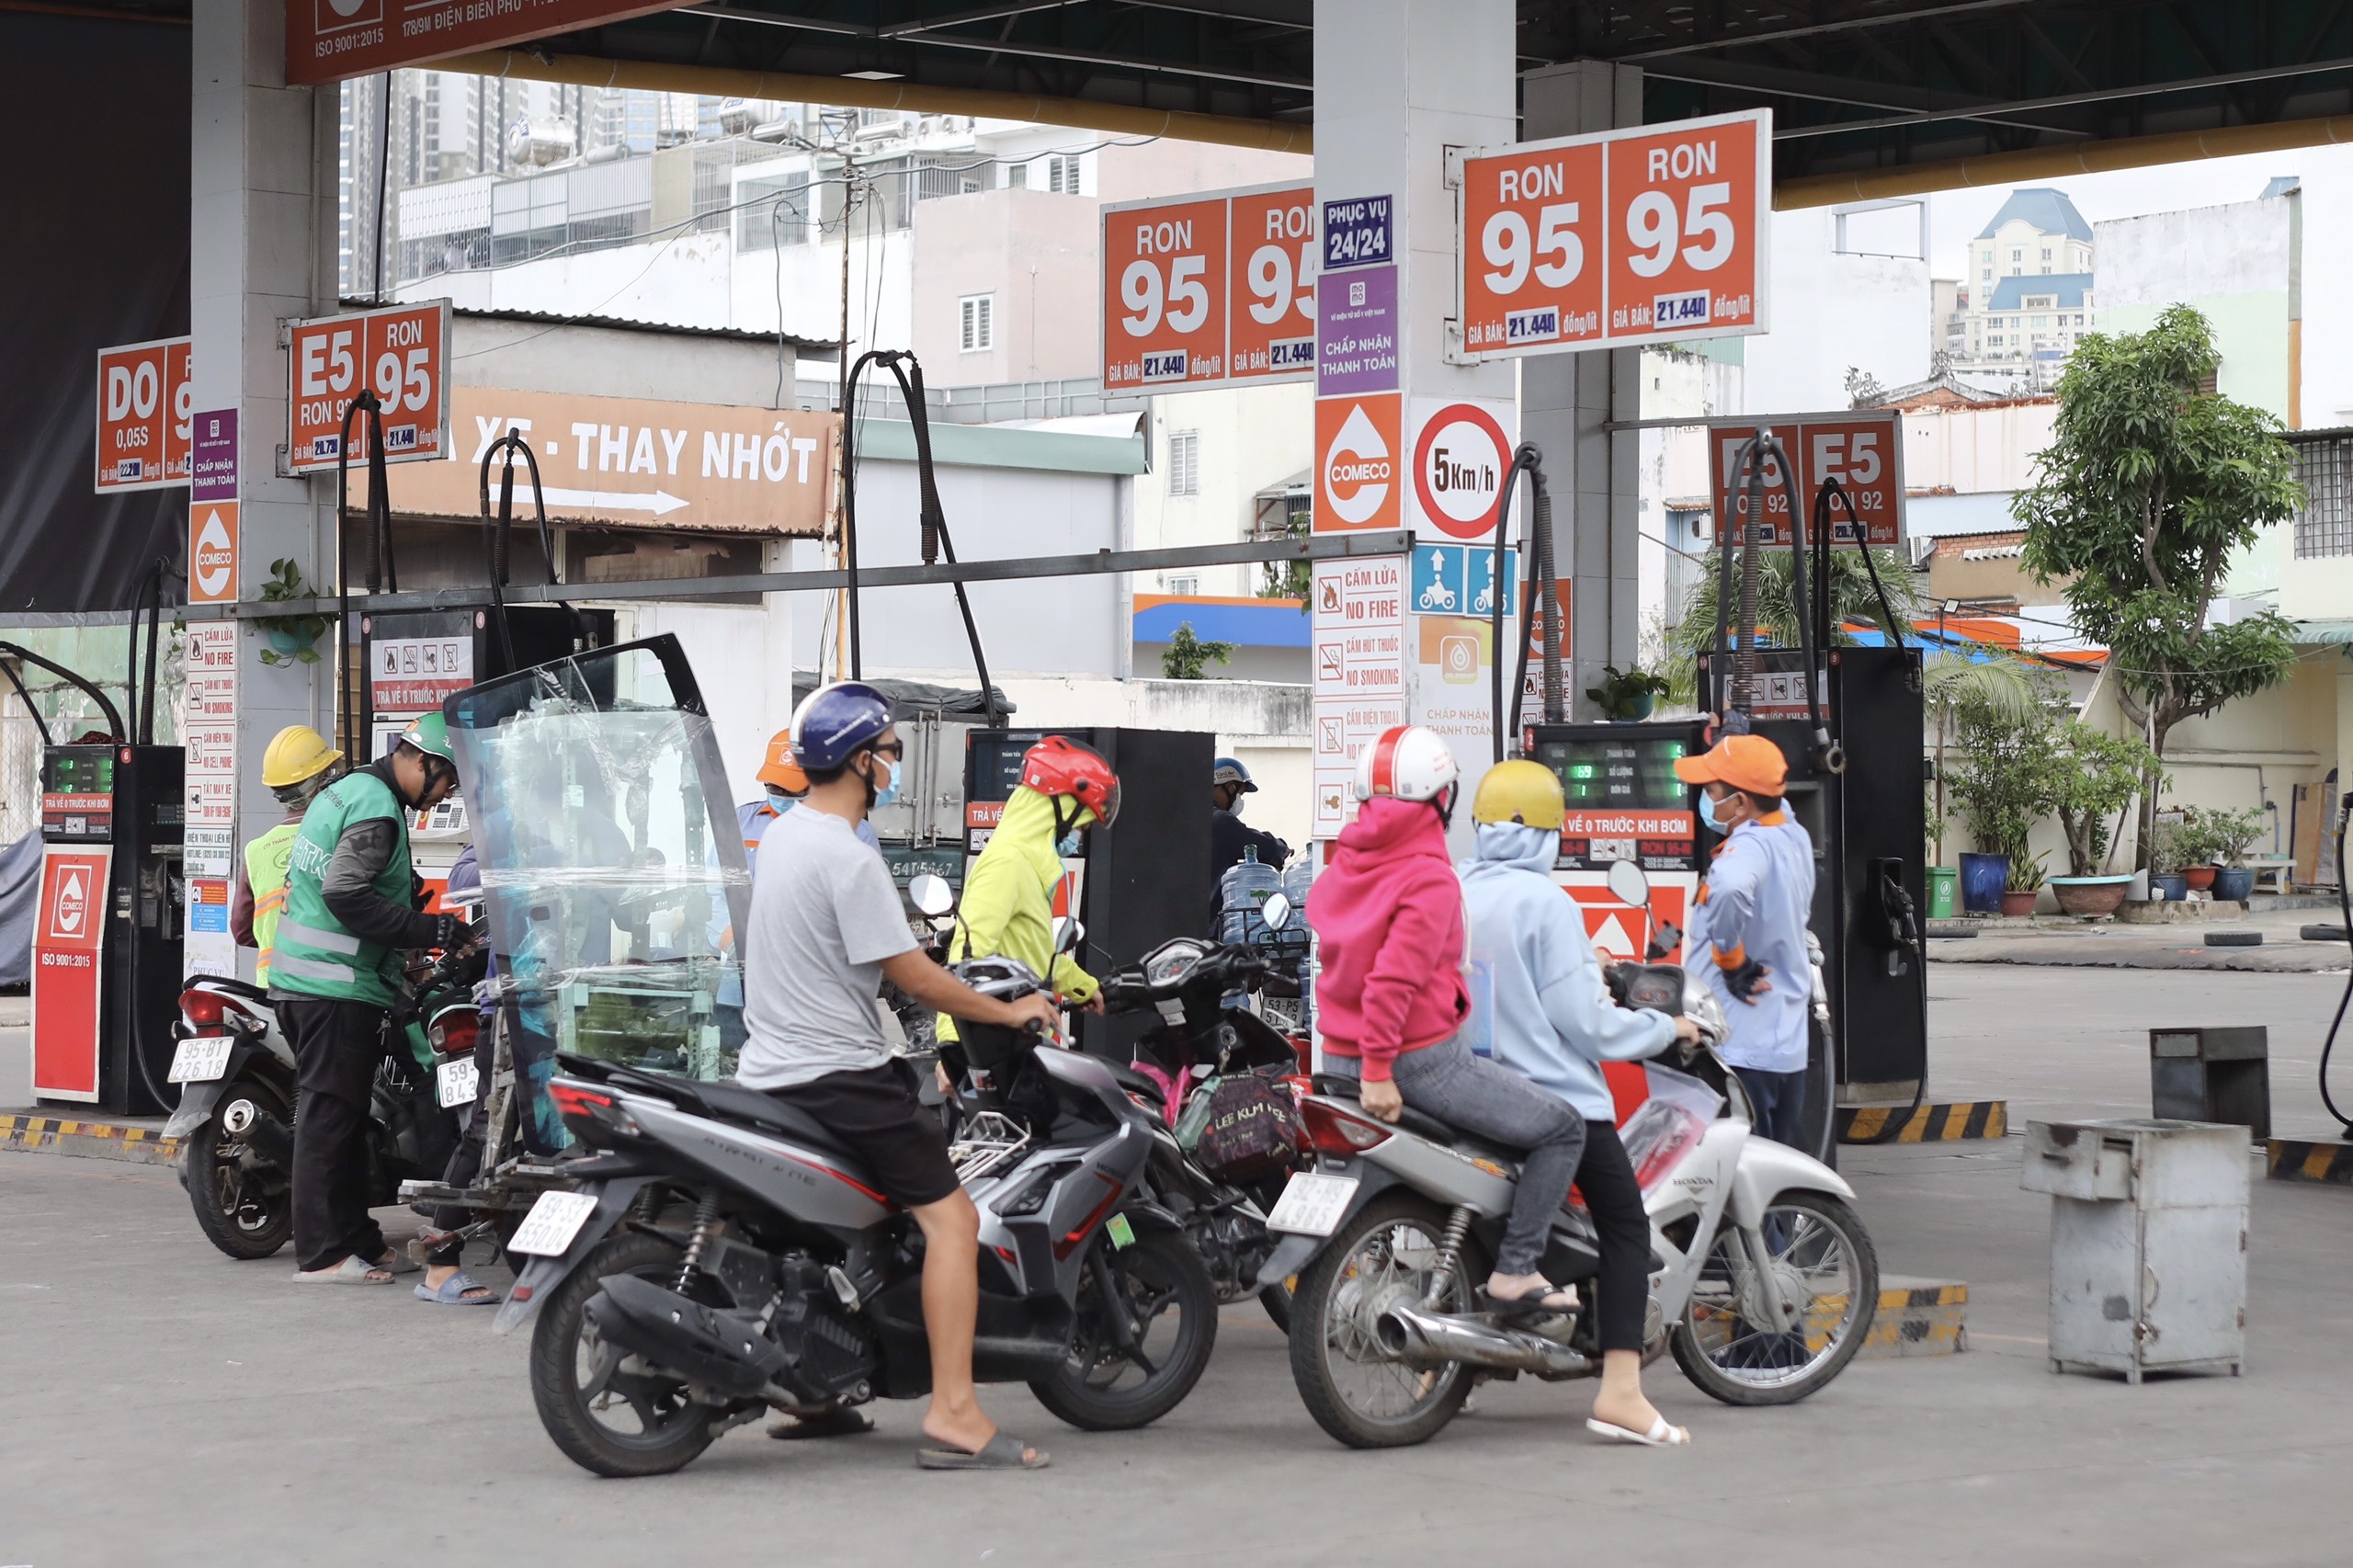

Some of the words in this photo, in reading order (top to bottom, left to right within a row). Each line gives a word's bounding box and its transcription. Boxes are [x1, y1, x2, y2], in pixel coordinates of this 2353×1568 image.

[403, 17, 431, 37] 178/9M
[435, 6, 461, 30] ĐIỆN
[315, 43, 333, 57] ISO
[335, 28, 384, 53] 9001:2015
[1648, 141, 1716, 182] RON
[1500, 163, 1563, 202] RON
[1328, 204, 1364, 226] PHỤC
[1369, 199, 1386, 222] VỤ
[1136, 220, 1191, 255] RON
[1627, 182, 1734, 278] 95
[1330, 227, 1385, 261] 24/24
[1482, 201, 1584, 295] 95
[1120, 255, 1209, 337] 95
[1613, 306, 1628, 328] GIÁ
[1631, 303, 1652, 326] BÁN:
[1658, 297, 1706, 321] 21.440
[1714, 294, 1750, 319] đồng/lít
[387, 319, 421, 347] RON
[1468, 322, 1483, 344] GIÁ
[1485, 320, 1505, 342] BÁN:
[1509, 312, 1555, 336] 21.440
[1563, 312, 1597, 336] đồng/lít
[1325, 335, 1356, 356] CHẤP
[1359, 334, 1392, 353] NHẬN
[301, 330, 354, 397] E5
[1109, 361, 1122, 382] GIÁ
[1124, 359, 1141, 381] BÁN:
[1144, 356, 1184, 377] 21.440
[1191, 355, 1221, 378] đồng/lít
[1235, 354, 1247, 371] GIÁ
[1250, 351, 1267, 369] BÁN:
[1323, 360, 1359, 375] THANH
[1364, 353, 1395, 370] TOÁN
[376, 347, 430, 415] 95
[108, 361, 158, 422] DO
[301, 401, 332, 426] RON
[117, 426, 148, 451] 0,05S
[572, 422, 687, 475] THAY
[701, 421, 816, 483] NHỚT
[1813, 432, 1881, 485] E5
[197, 459, 213, 472] CHẤP
[215, 459, 233, 472] NHẬN
[1332, 462, 1390, 482] COMECO
[195, 477, 215, 487] THANH
[217, 473, 234, 485] TOÁN
[1768, 494, 1788, 513] 92
[1862, 491, 1882, 510] 92
[199, 552, 232, 565] COMECO
[1346, 567, 1370, 586] CẤM
[1375, 564, 1397, 585] LỬA
[1347, 601, 1364, 619] NO
[1370, 599, 1398, 618] FIRE
[205, 628, 219, 642] CẤM
[221, 627, 233, 641] LỬA
[1347, 635, 1361, 653] CẤM
[1363, 636, 1375, 653] HÚT
[1378, 633, 1399, 652] THUỐC
[205, 653, 215, 665] NO
[218, 652, 233, 665] FIRE
[1347, 670, 1358, 686] NO
[1361, 668, 1399, 686] SMOKING
[377, 687, 390, 704] TRẢ
[410, 687, 434, 704] TRƯỚC
[204, 702, 210, 714] NO
[212, 702, 233, 713] SMOKING
[1347, 707, 1361, 725] CẤM
[1363, 708, 1378, 728] ĐIỆN
[1427, 707, 1456, 720] CHẤP
[1459, 708, 1489, 722] NHẬN
[124, 752, 129, 760] 6
[1347, 744, 1356, 760] NO
[213, 781, 224, 794] MÁY
[226, 784, 232, 794] XE
[46, 797, 55, 808] TRẢ
[57, 796, 63, 808] VỀ
[69, 798, 86, 808] TRƯỚC
[87, 800, 97, 808] KHI
[97, 799, 108, 808] BƠM
[972, 807, 989, 821] TRẢ
[992, 806, 1002, 821] VỀ
[1568, 814, 1583, 833] VỀ
[1586, 821, 1592, 833] 0
[1595, 816, 1634, 833] TRƯỚC
[1638, 820, 1657, 833] KHI
[1661, 819, 1687, 833] BƠM
[62, 902, 83, 911] COMECO
[42, 953, 54, 965] ISO
[56, 954, 90, 967] 9001:2015
[1268, 1000, 1298, 1012] 53-P5
[184, 1040, 223, 1059] 95-B1
[174, 1060, 223, 1079] 226.18
[1215, 1112, 1233, 1131] LEE
[1237, 1103, 1264, 1120] KUM
